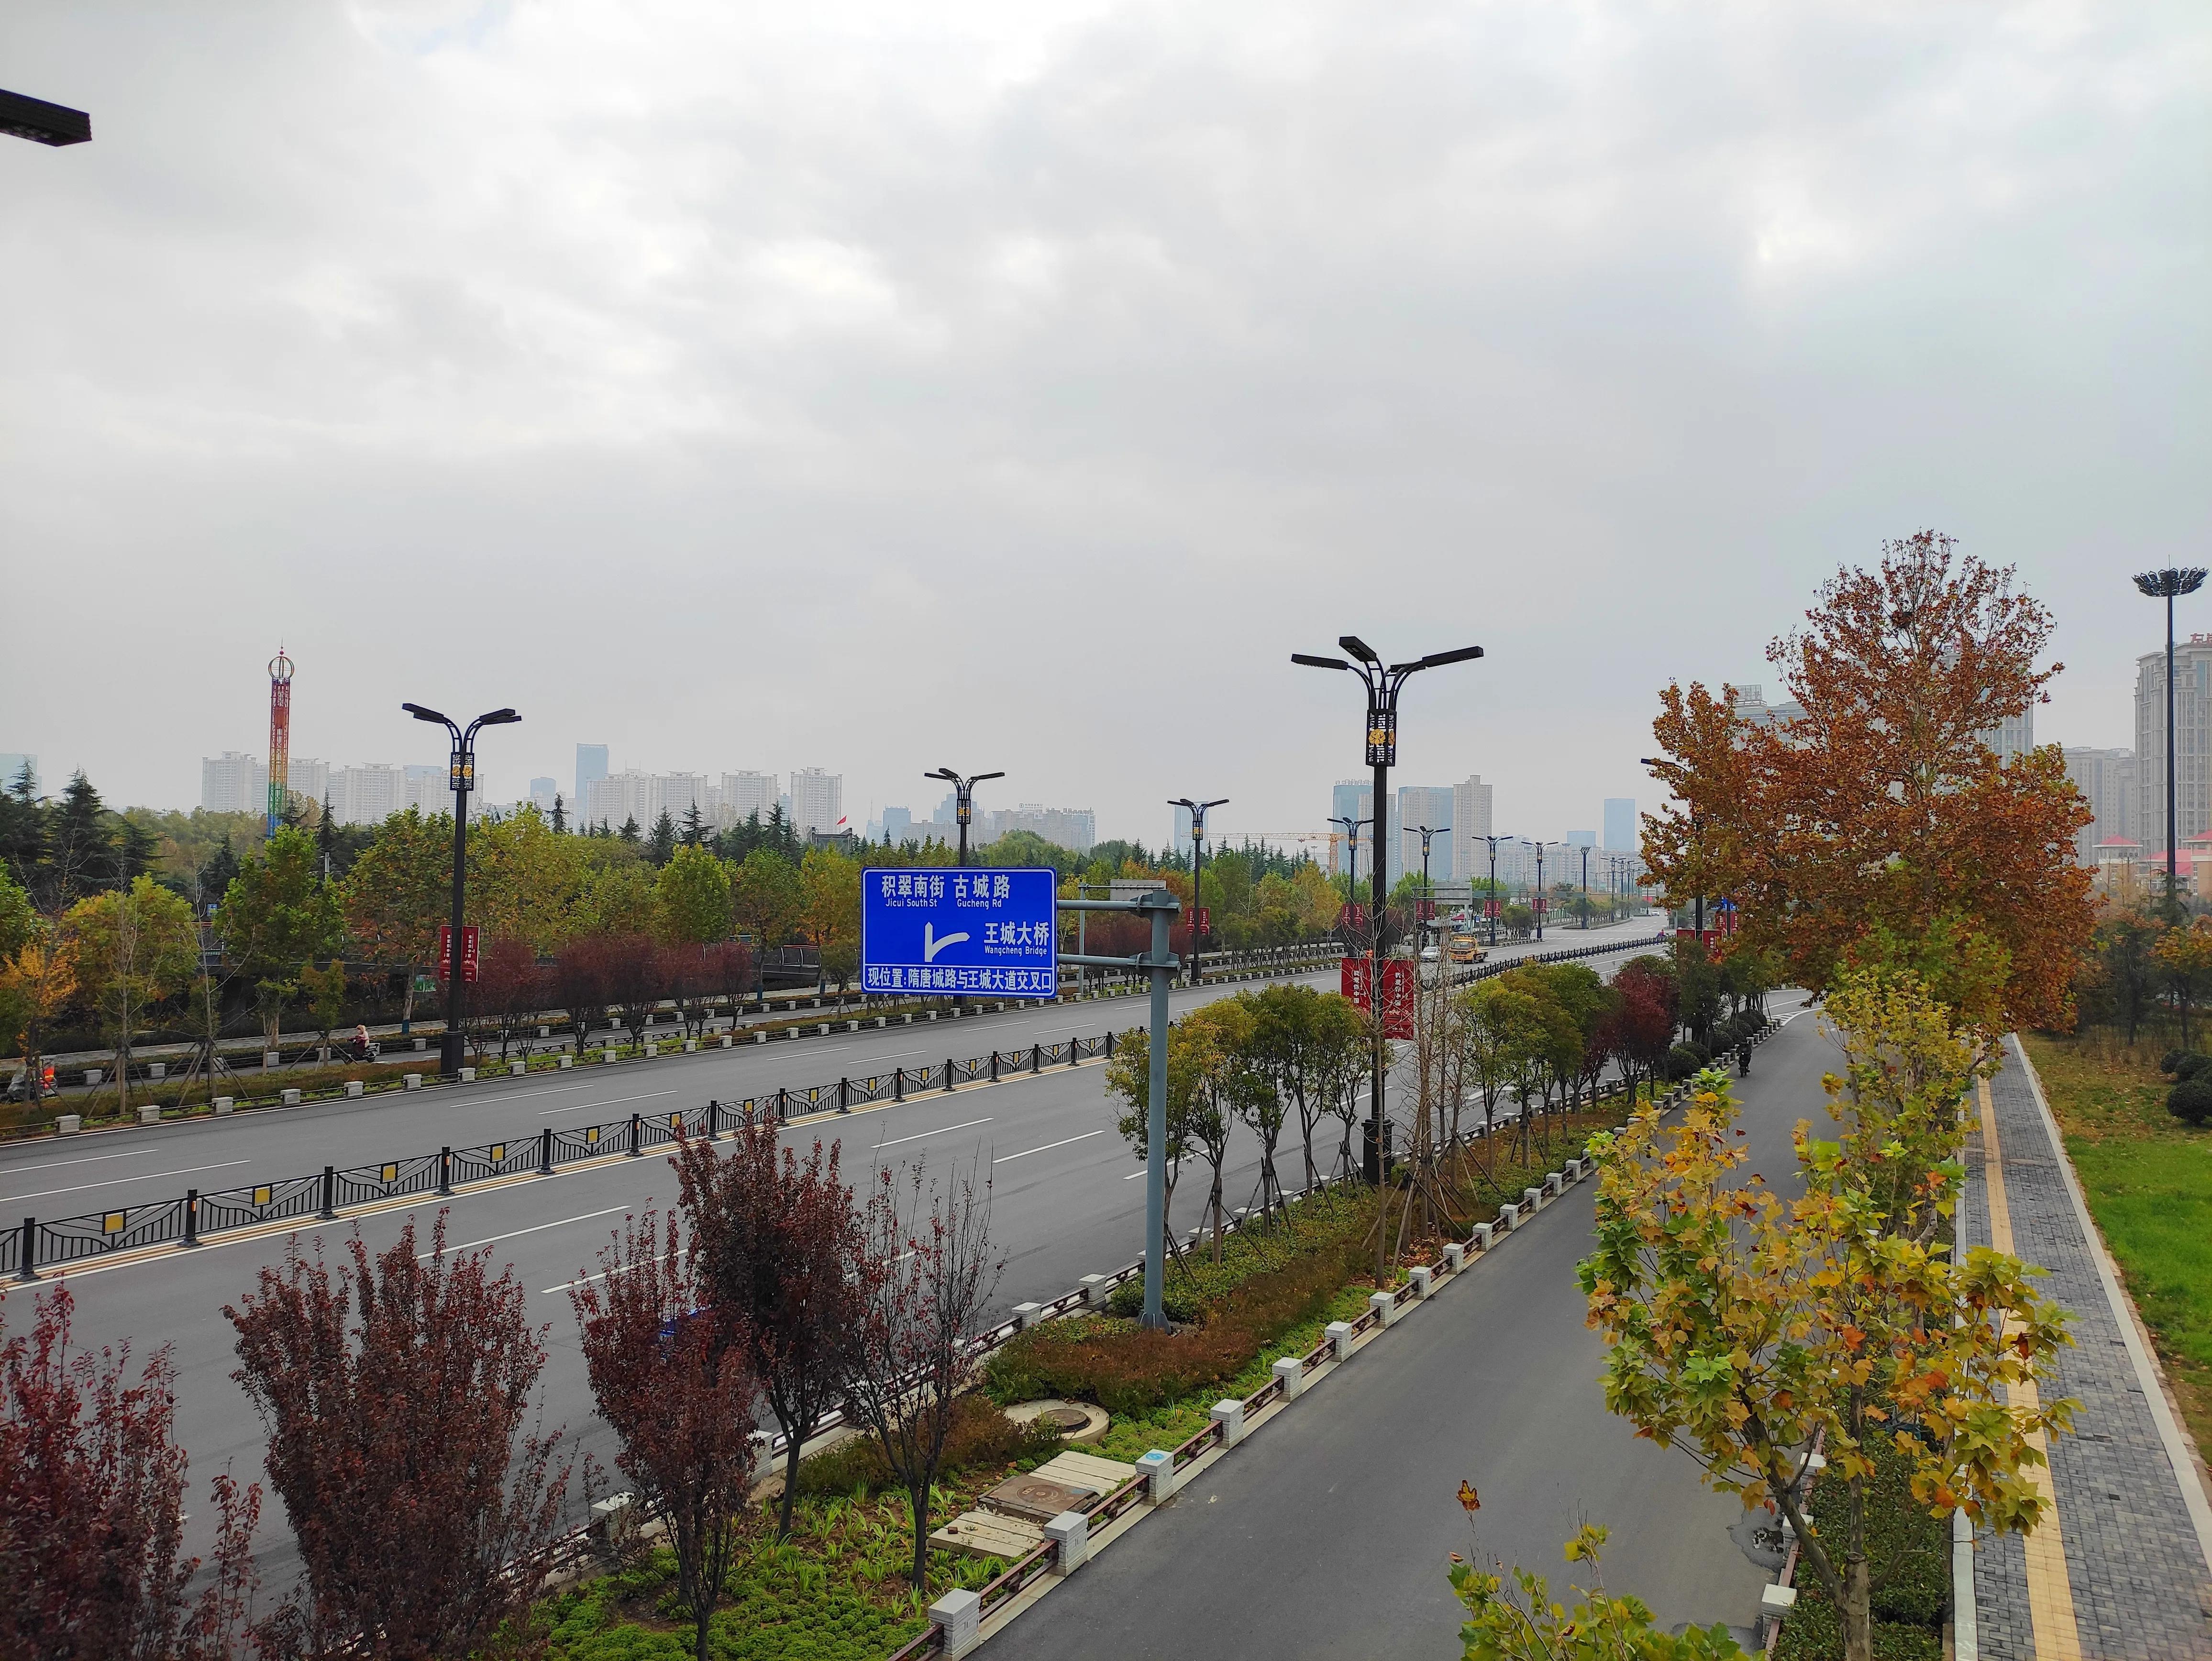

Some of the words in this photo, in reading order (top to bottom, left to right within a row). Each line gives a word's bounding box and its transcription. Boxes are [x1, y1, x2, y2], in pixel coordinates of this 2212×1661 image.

[882, 875, 945, 898] 积翠南街
[953, 875, 1010, 899] 古城路
[885, 899, 904, 907] Jicui
[907, 899, 928, 908] South
[929, 899, 937, 908] St
[957, 899, 989, 909] Gucheng
[992, 899, 1002, 908] Rd
[984, 921, 1049, 946] 王城大桥
[984, 945, 1022, 956] Wangcheng
[1025, 946, 1047, 957] Bridge
[868, 967, 1052, 991] 现位置:隋唐城路与王城大道交叉口
